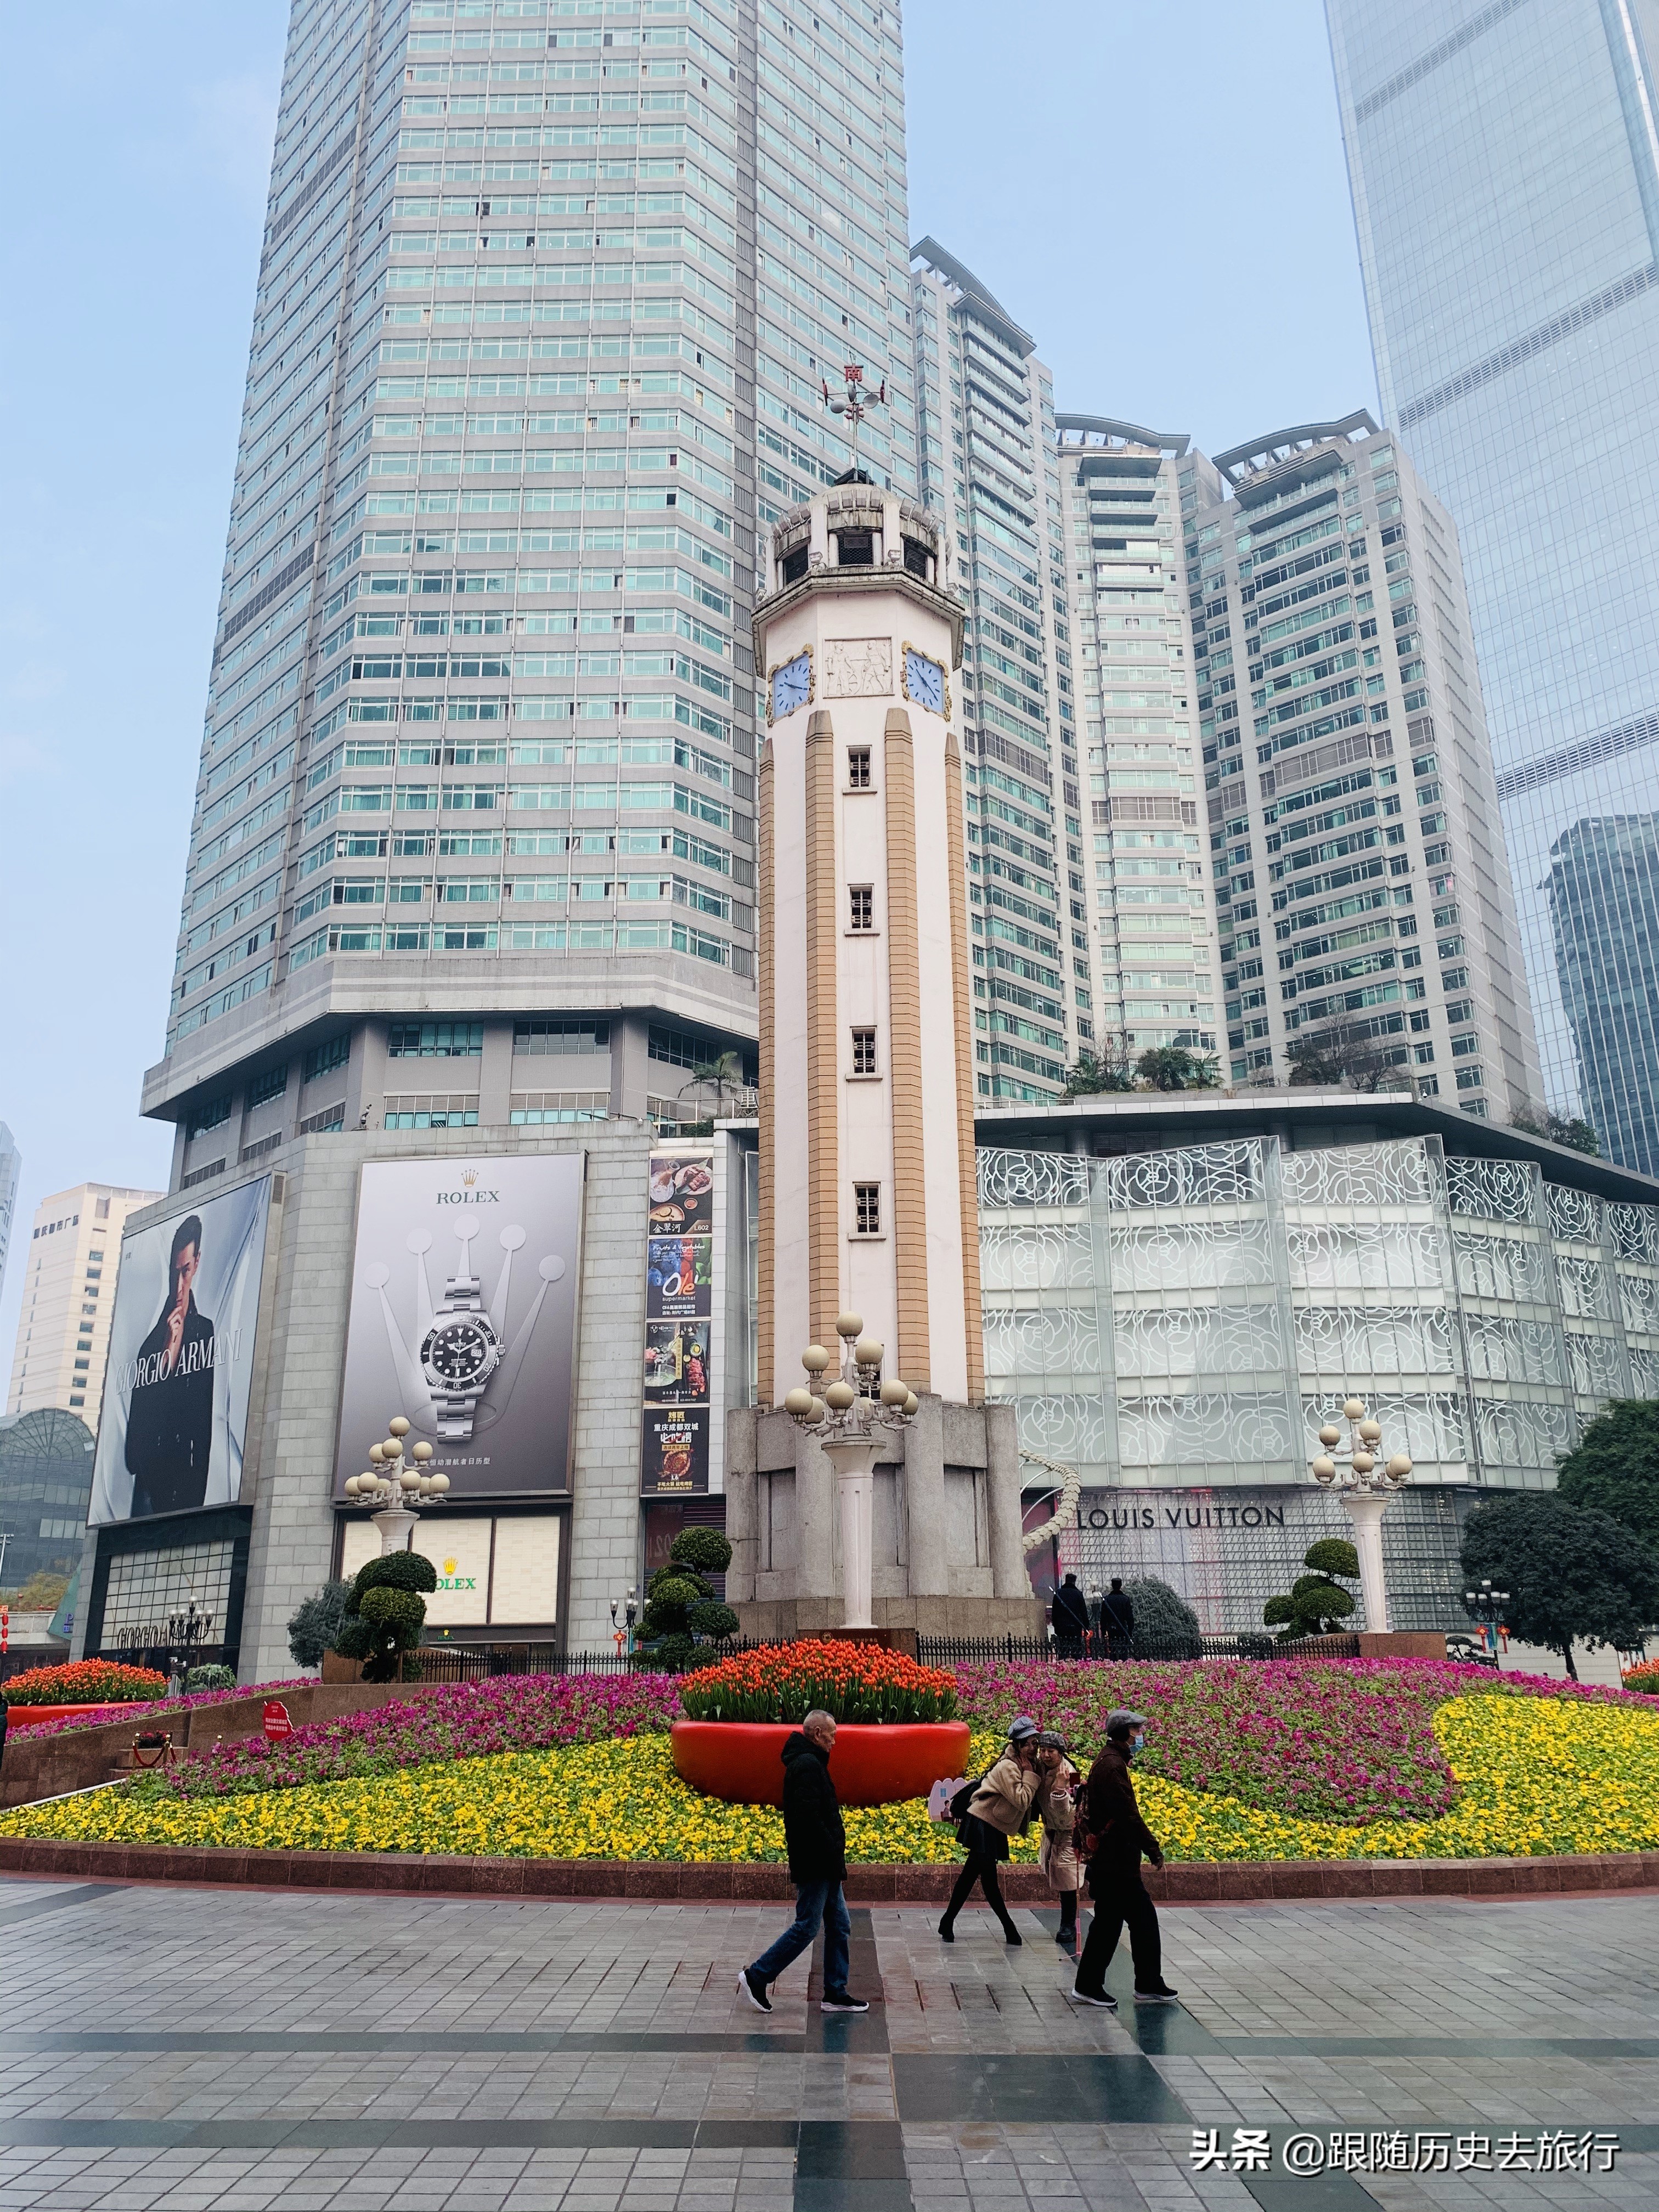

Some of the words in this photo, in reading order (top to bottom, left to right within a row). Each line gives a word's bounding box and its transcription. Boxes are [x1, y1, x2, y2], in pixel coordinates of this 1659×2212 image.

[844, 363, 864, 382] 南
[436, 1191, 500, 1204] ROLEX
[653, 1223, 681, 1234] 金翠河
[116, 1349, 172, 1395] GIORGIO
[174, 1328, 242, 1377] ARMANI
[654, 1423, 699, 1431] 重庆成都双城
[661, 1432, 692, 1443] 必吃榜
[414, 1457, 490, 1466] 恒动潜航者日历型
[1077, 1508, 1154, 1530] LOUIS
[1165, 1506, 1284, 1528] VUITTON
[435, 1578, 476, 1590] OLEX
